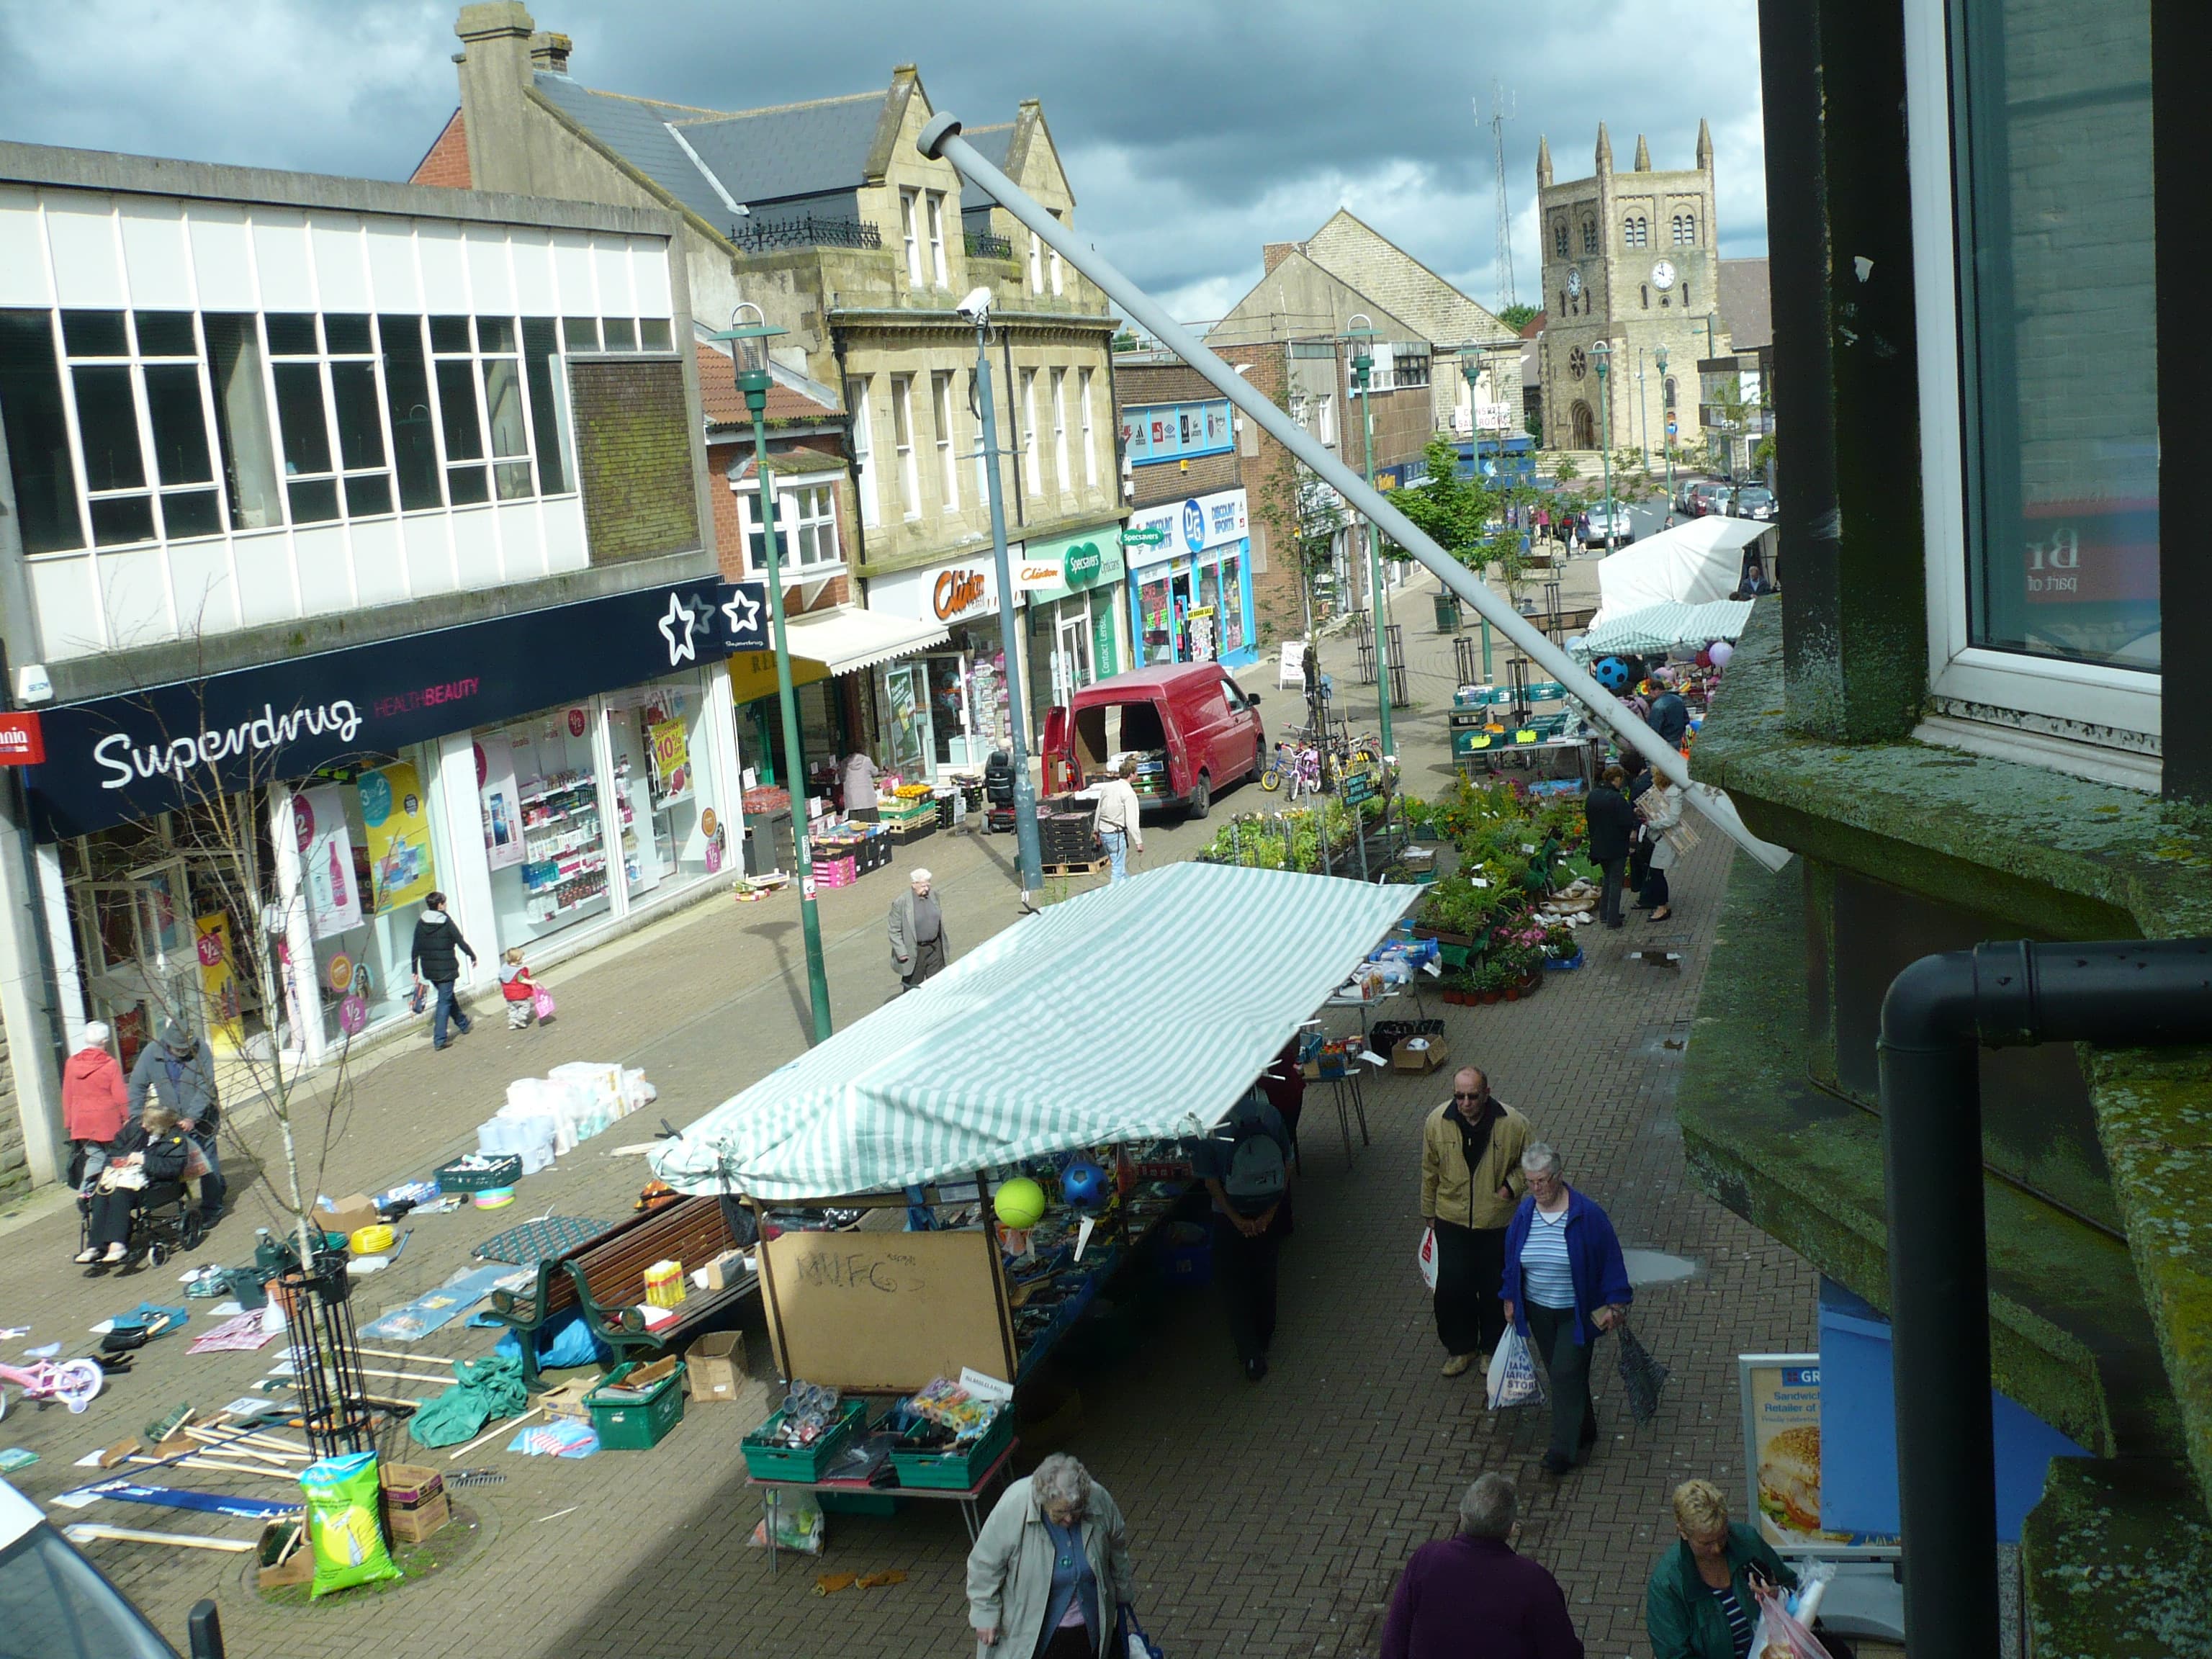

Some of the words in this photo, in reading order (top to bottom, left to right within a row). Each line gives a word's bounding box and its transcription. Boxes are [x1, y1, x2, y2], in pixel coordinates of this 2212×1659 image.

[1211, 502, 1236, 521] DISCOUNT
[1215, 517, 1235, 535] SPORTS
[1123, 531, 1159, 543] Specsavers
[1070, 554, 1100, 574] Specsavers
[1100, 558, 1120, 576] Opticians
[1020, 567, 1058, 582] Clinton
[933, 570, 985, 621] Clinton
[1102, 643, 1110, 674] Contact
[94, 700, 363, 789] Superdrug
[377, 778, 387, 796] 2
[1765, 1403, 1802, 1412] Retailer
[1806, 1403, 1817, 1412] of
